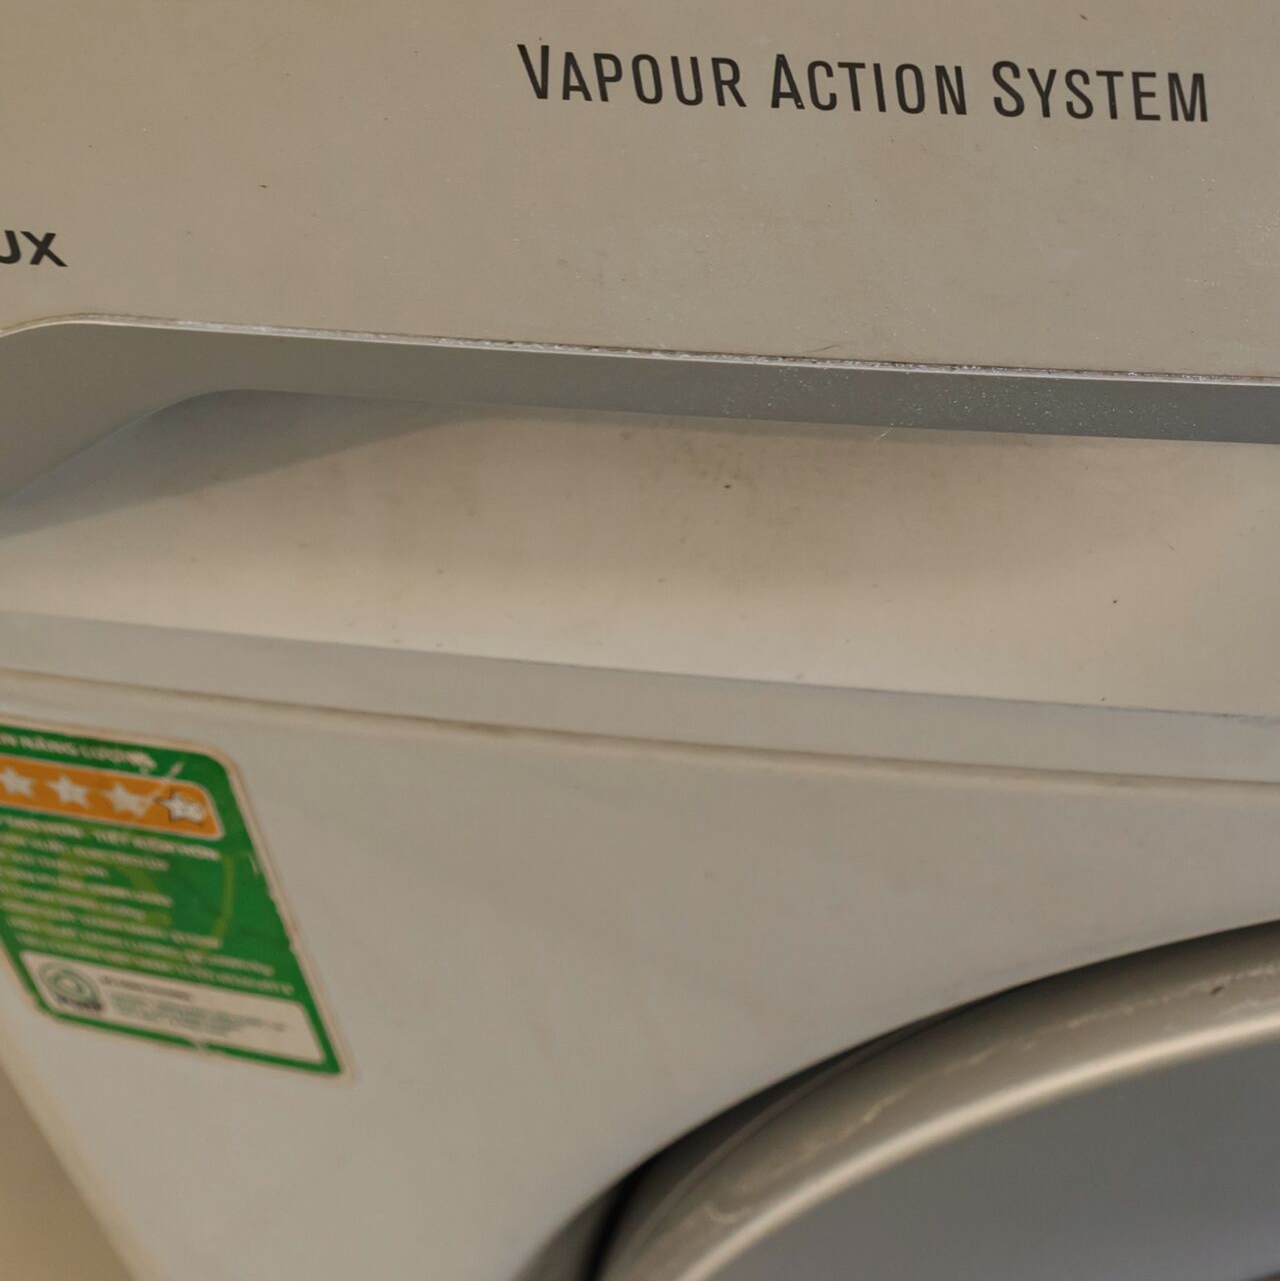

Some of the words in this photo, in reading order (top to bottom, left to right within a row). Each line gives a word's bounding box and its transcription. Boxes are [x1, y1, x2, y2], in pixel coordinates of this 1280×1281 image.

[516, 43, 747, 108] VAPOUR
[770, 53, 968, 116] ACTION
[992, 60, 1208, 123] SYSTEM
